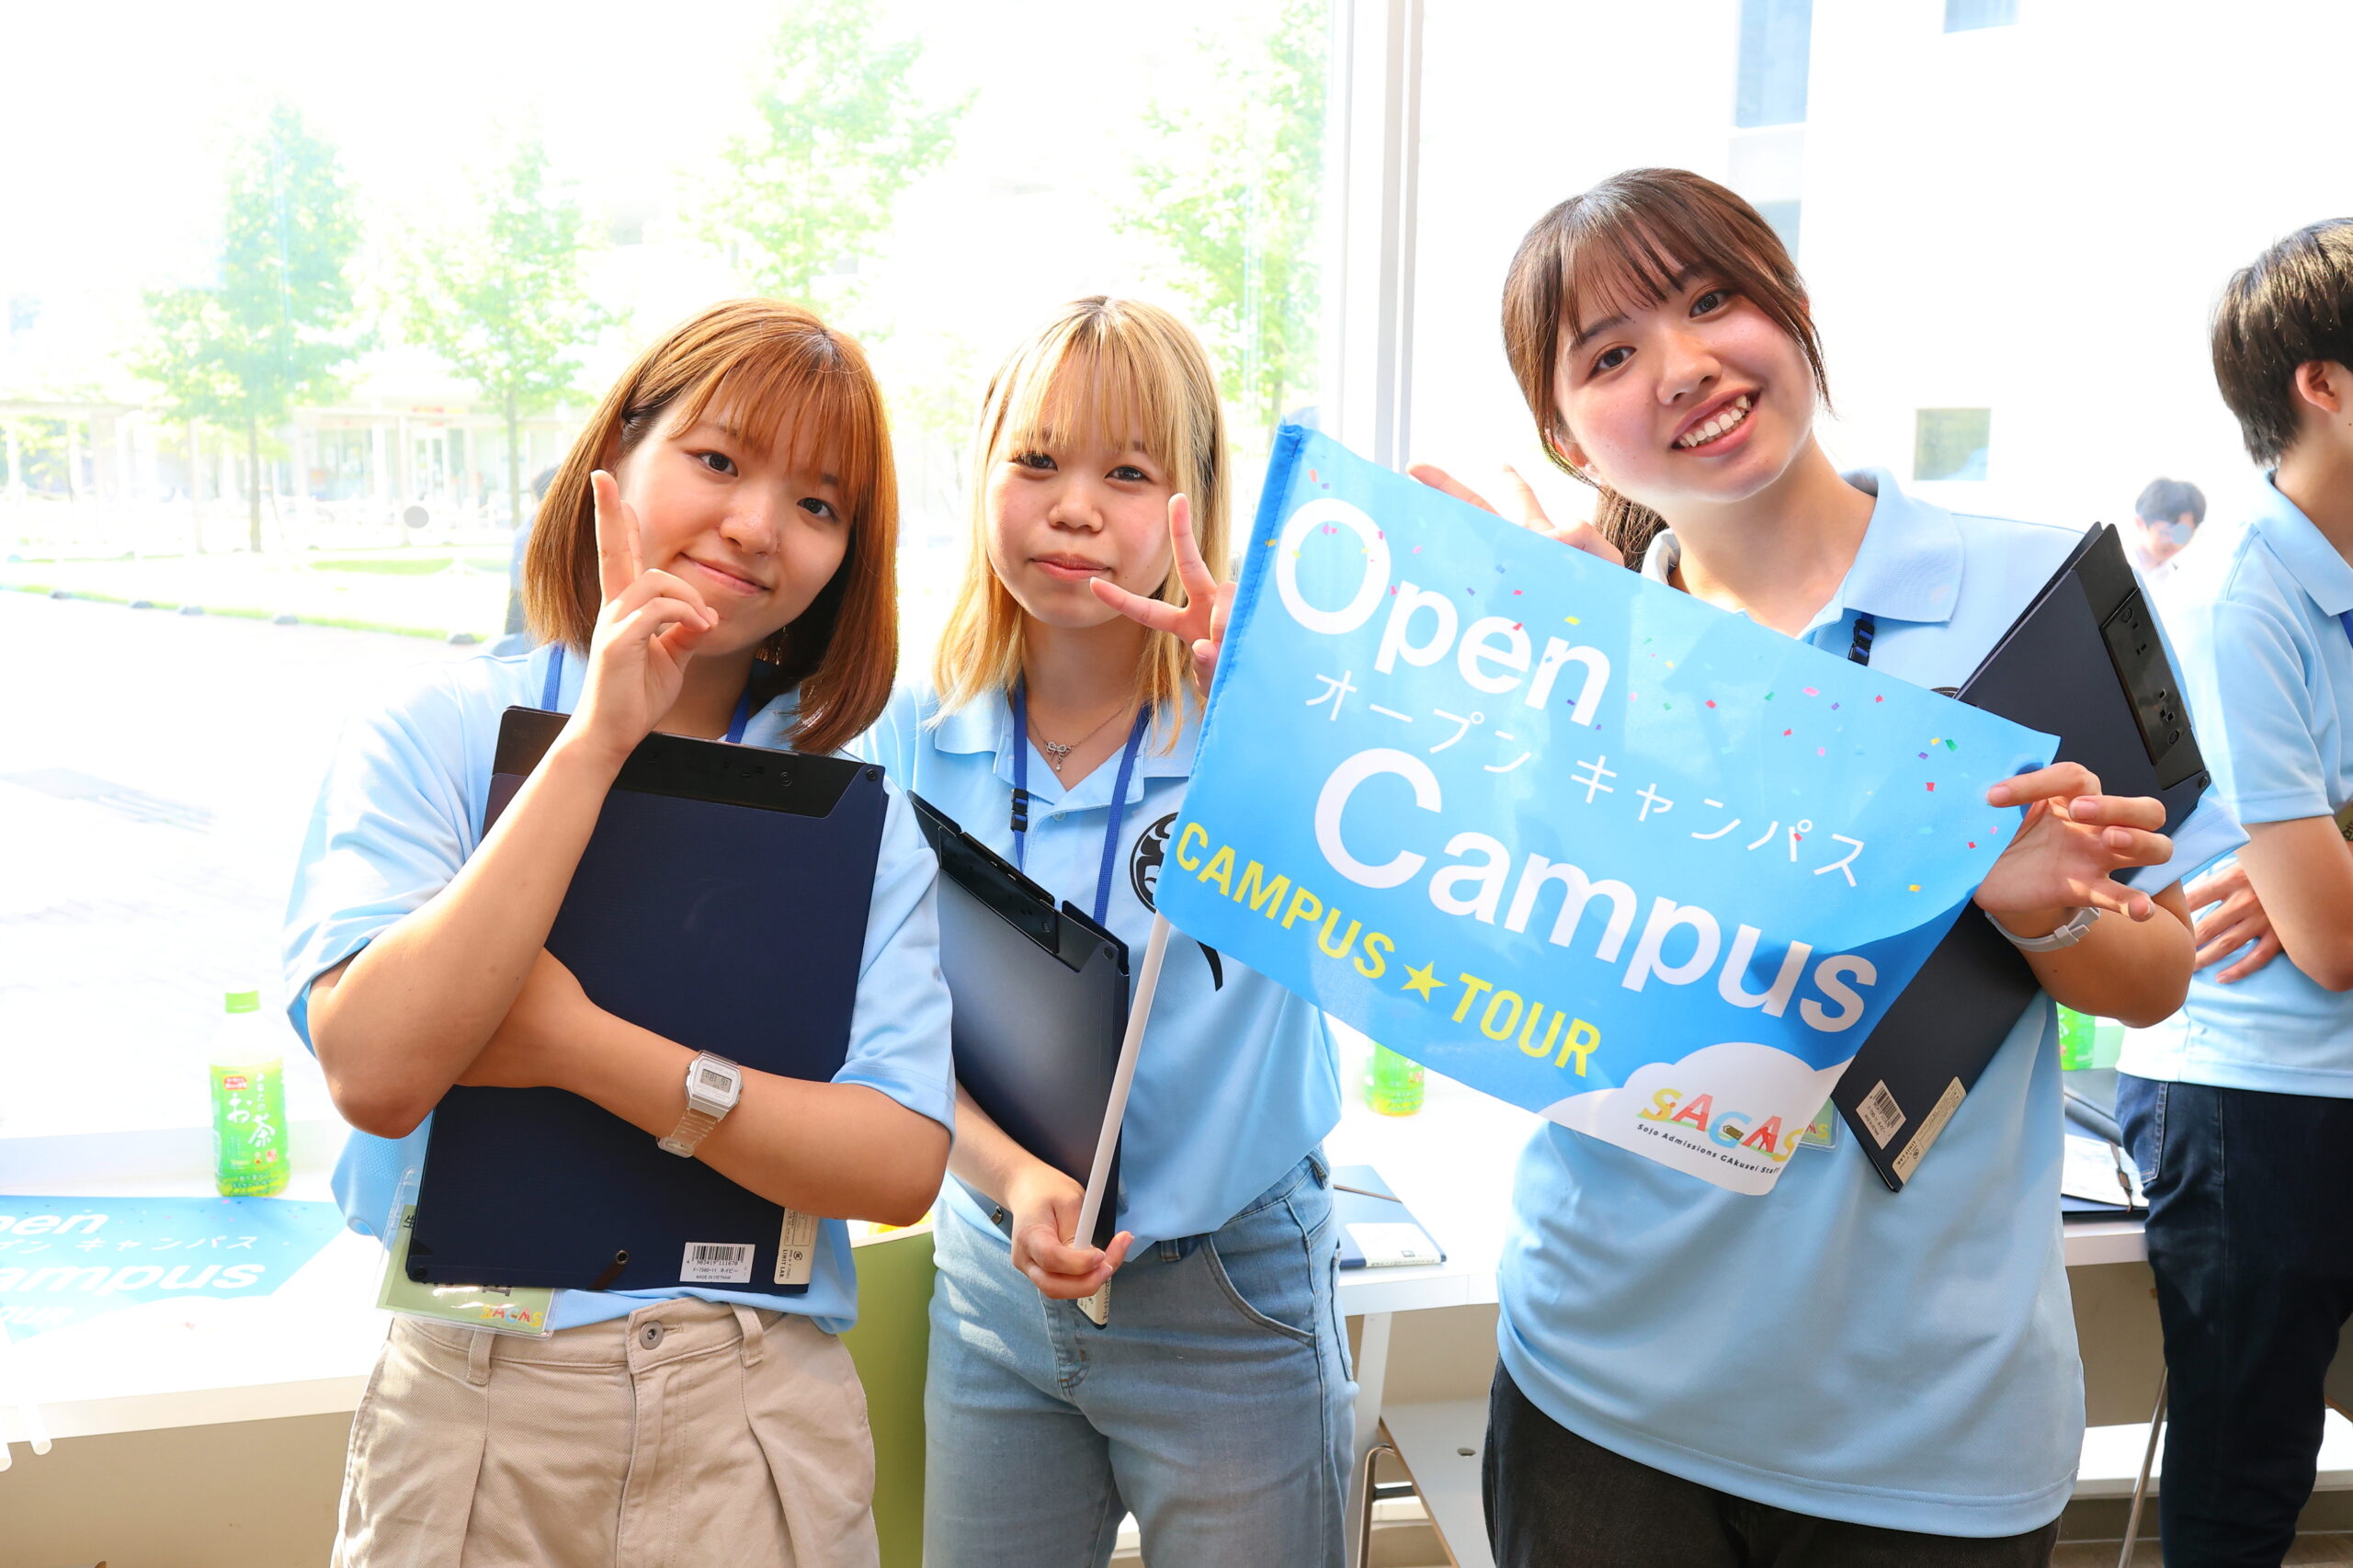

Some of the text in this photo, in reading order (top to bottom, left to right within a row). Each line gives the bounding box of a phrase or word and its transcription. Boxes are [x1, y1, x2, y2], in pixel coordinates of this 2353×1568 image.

[1275, 498, 1610, 726] Open
[1305, 669, 1866, 887] オープン キャンパス
[1176, 822, 1601, 1077] CAMPUS TOUR
[1313, 747, 1878, 1033] Campus
[226, 1092, 276, 1148] お茶
[1637, 1088, 1804, 1163] SAGAS
[1637, 1123, 1659, 1136] Sojo
[1662, 1132, 1717, 1158] Admissions
[1721, 1154, 1759, 1172] GAkusei
[75, 1234, 257, 1252] キャンパス
